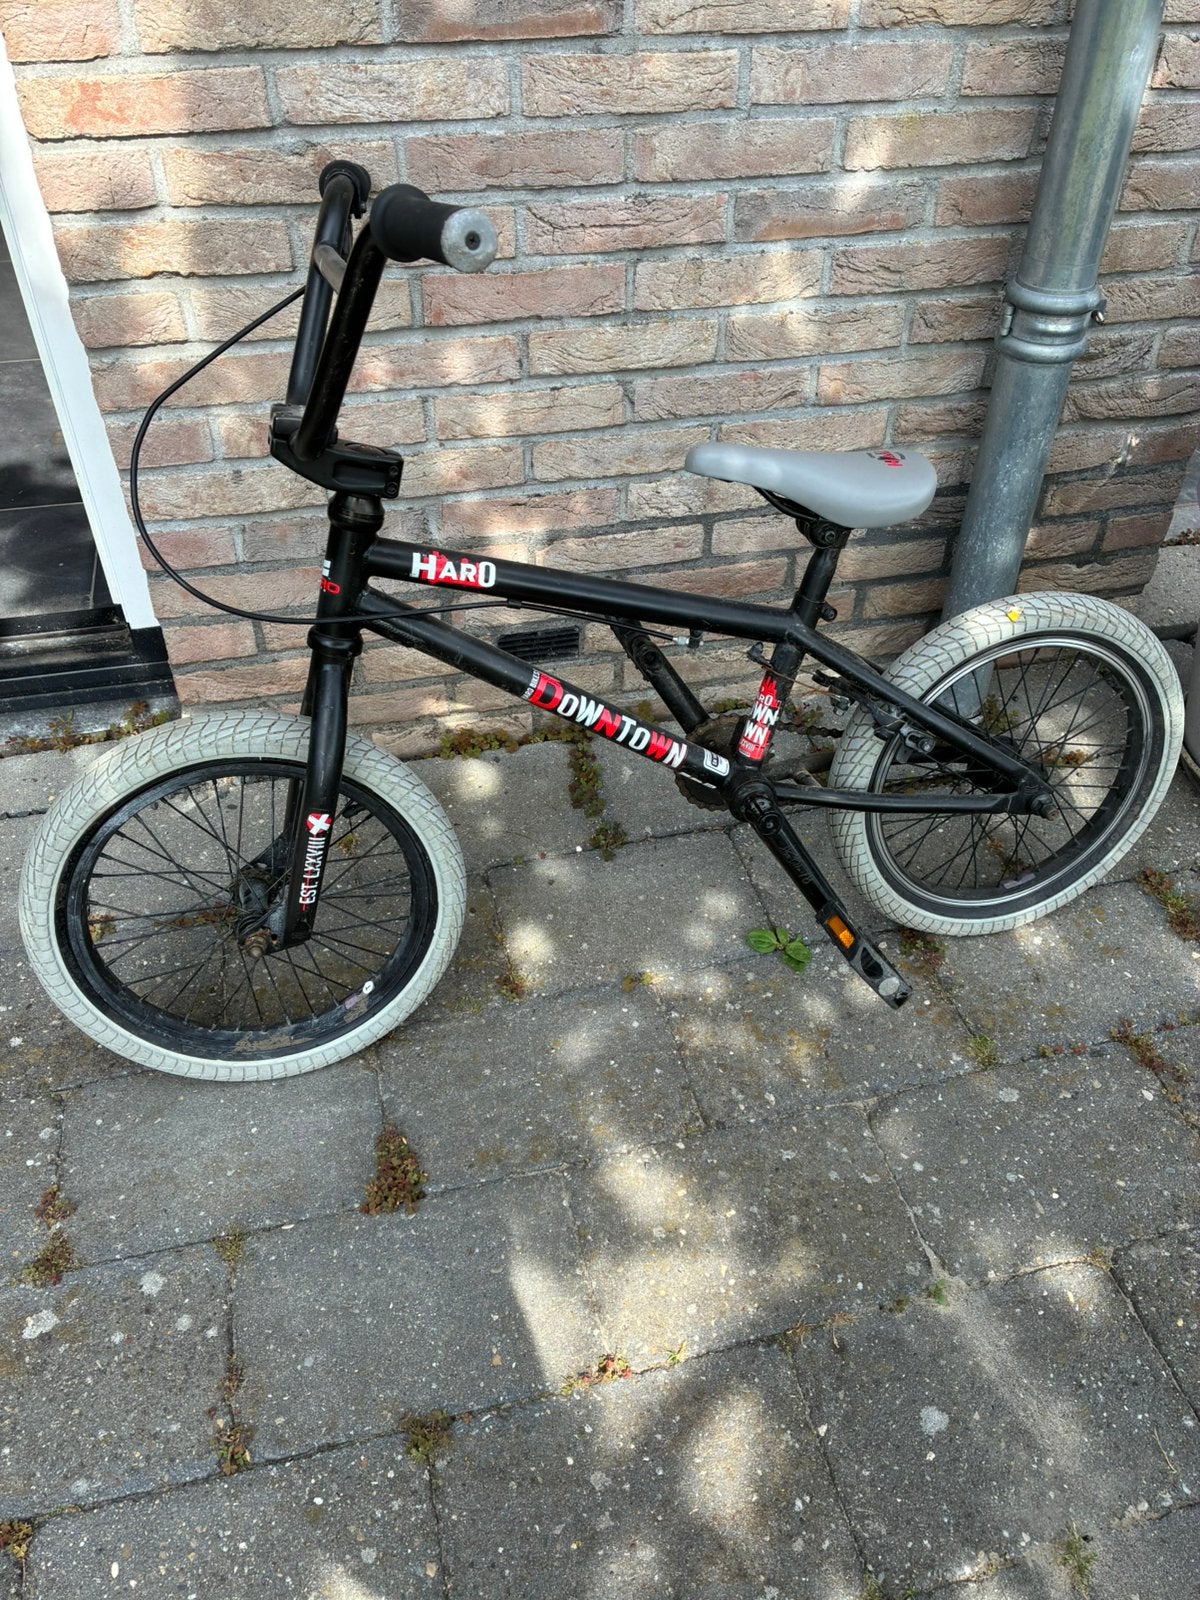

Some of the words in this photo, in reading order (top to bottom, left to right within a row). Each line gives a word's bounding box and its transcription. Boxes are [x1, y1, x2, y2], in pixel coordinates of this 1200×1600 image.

[410, 552, 496, 588] HARO
[529, 672, 688, 768] DOWNTOWN
[303, 837, 326, 878] LXXVIII
[299, 882, 319, 904] EST.
